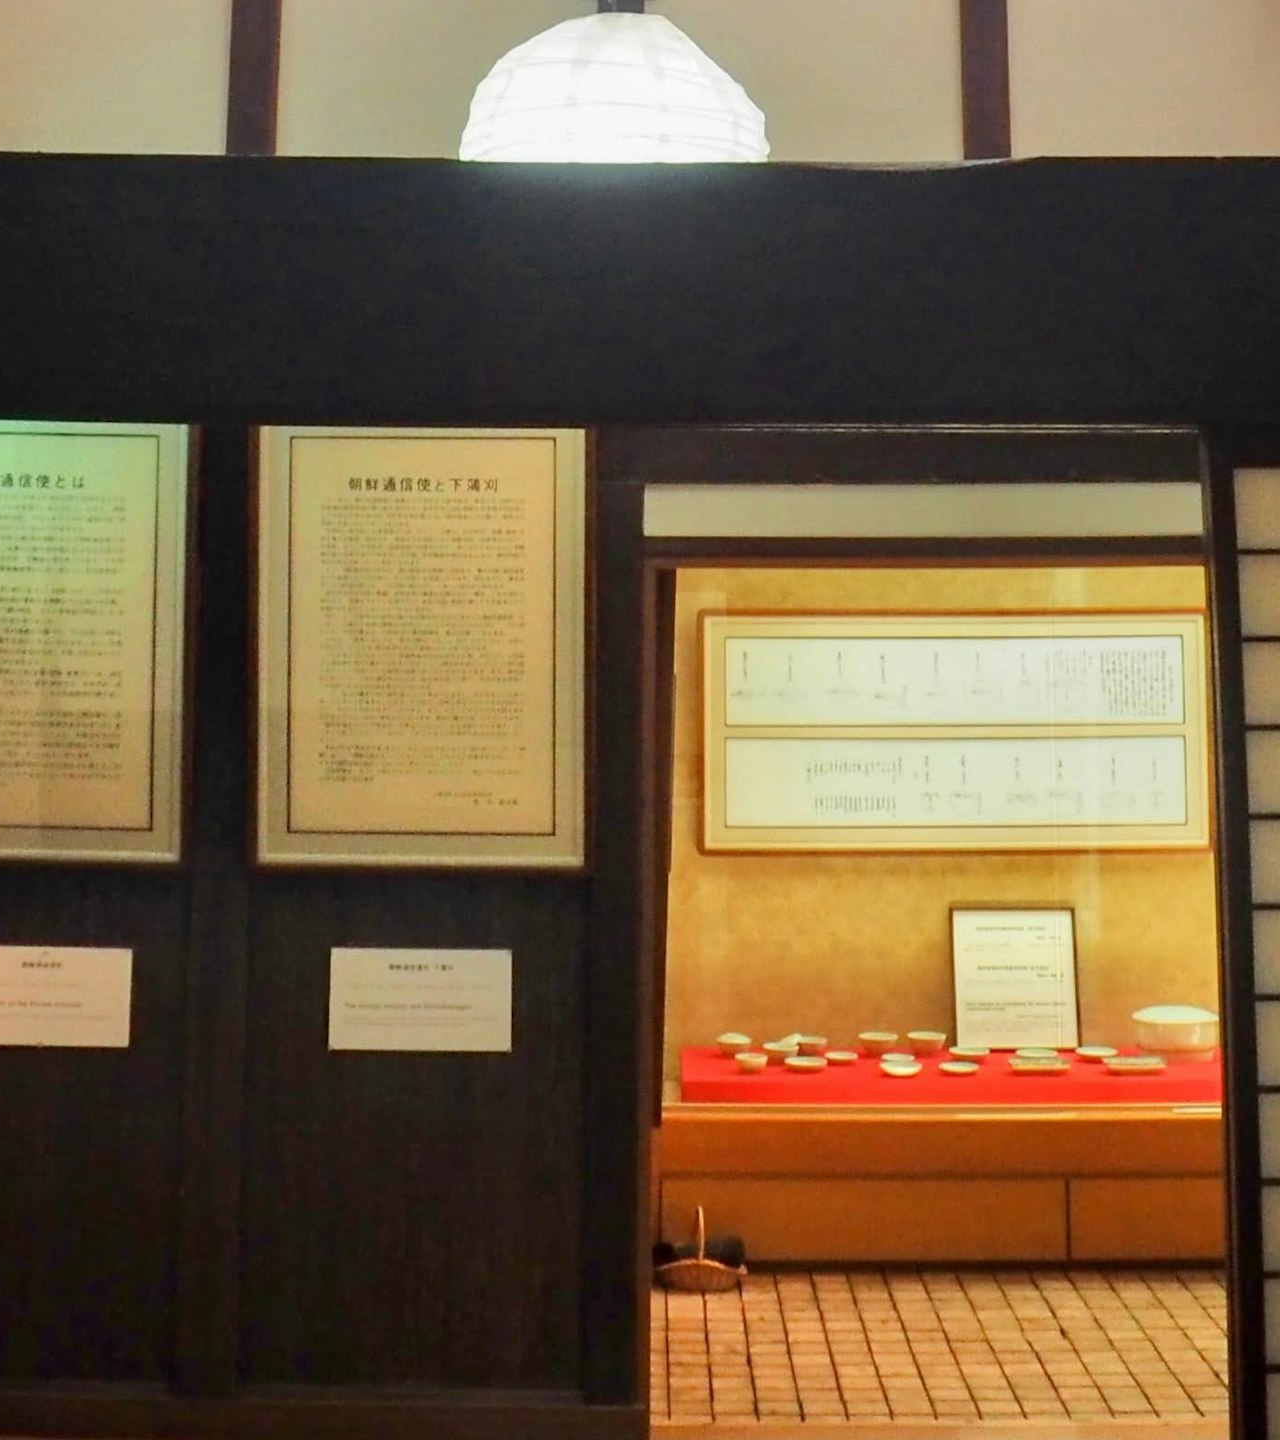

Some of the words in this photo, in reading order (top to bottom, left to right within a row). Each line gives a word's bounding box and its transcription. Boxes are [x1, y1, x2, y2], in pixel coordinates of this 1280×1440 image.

[348, 477, 498, 493] 朝鮮通信使と下蒲刈
